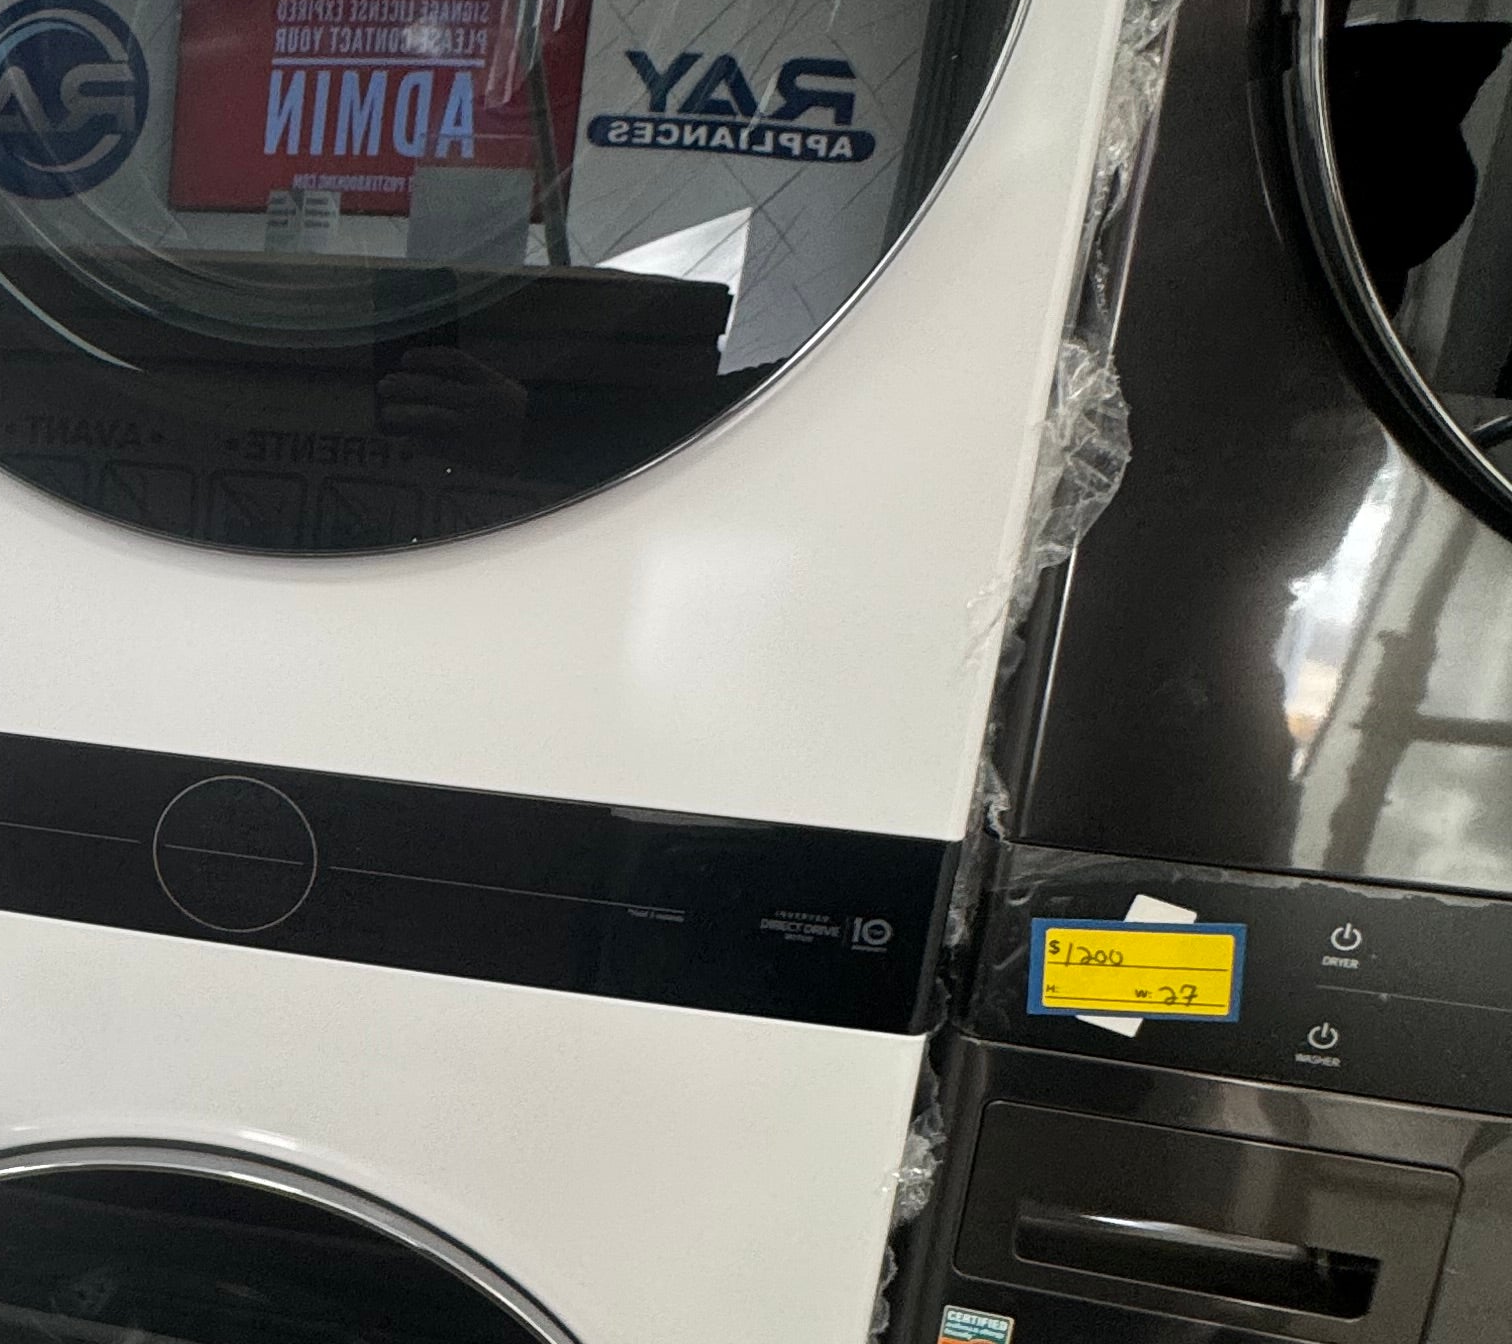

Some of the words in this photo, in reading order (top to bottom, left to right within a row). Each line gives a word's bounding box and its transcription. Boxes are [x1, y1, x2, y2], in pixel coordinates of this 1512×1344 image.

[1064, 942, 1125, 968] 1200
[1321, 955, 1360, 970] DRYER
[1158, 983, 1199, 1007] 27
[947, 1309, 1009, 1332] CERTIFIED
